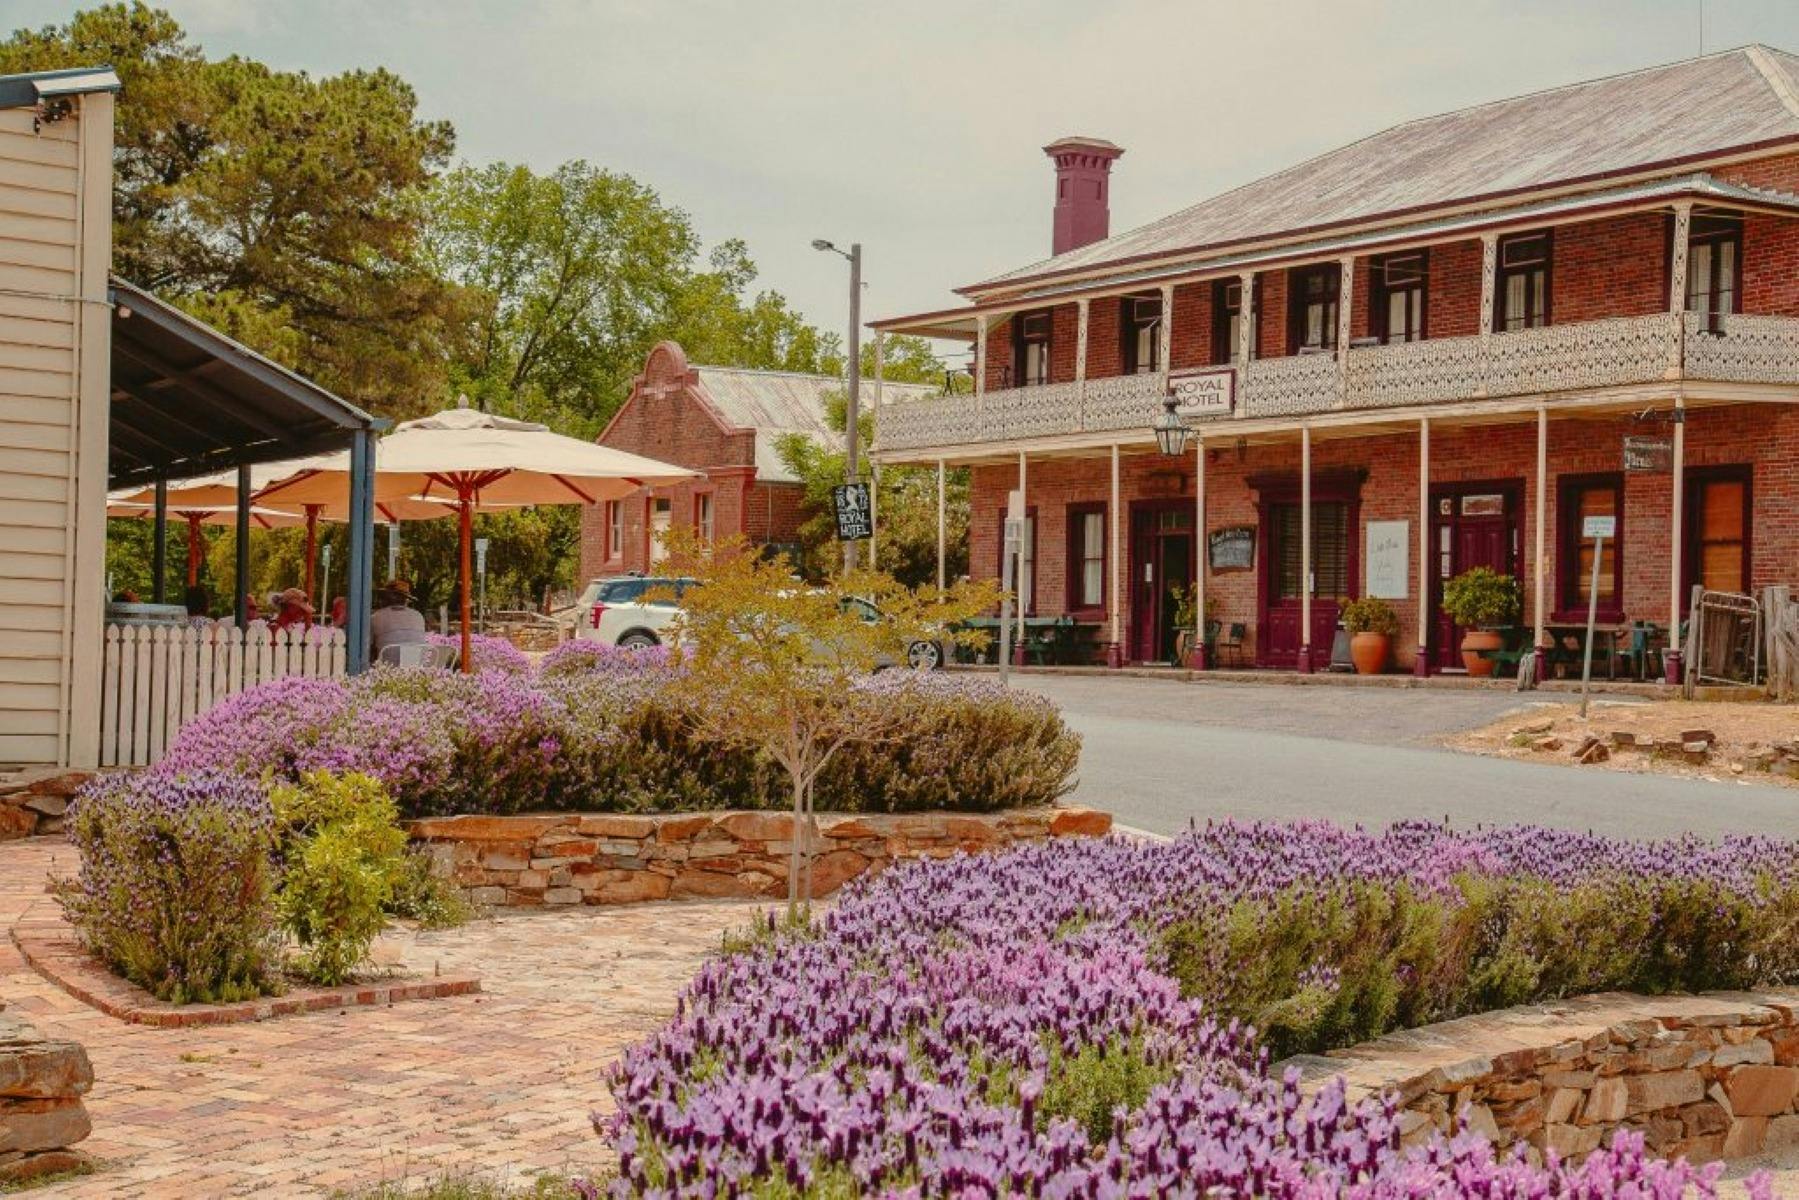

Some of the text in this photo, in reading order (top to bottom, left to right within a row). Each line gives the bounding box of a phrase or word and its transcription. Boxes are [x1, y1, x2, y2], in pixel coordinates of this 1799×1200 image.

[1175, 379, 1225, 394] ROYAL
[839, 511, 870, 524] ROYAL
[840, 523, 870, 538] HOTEL
